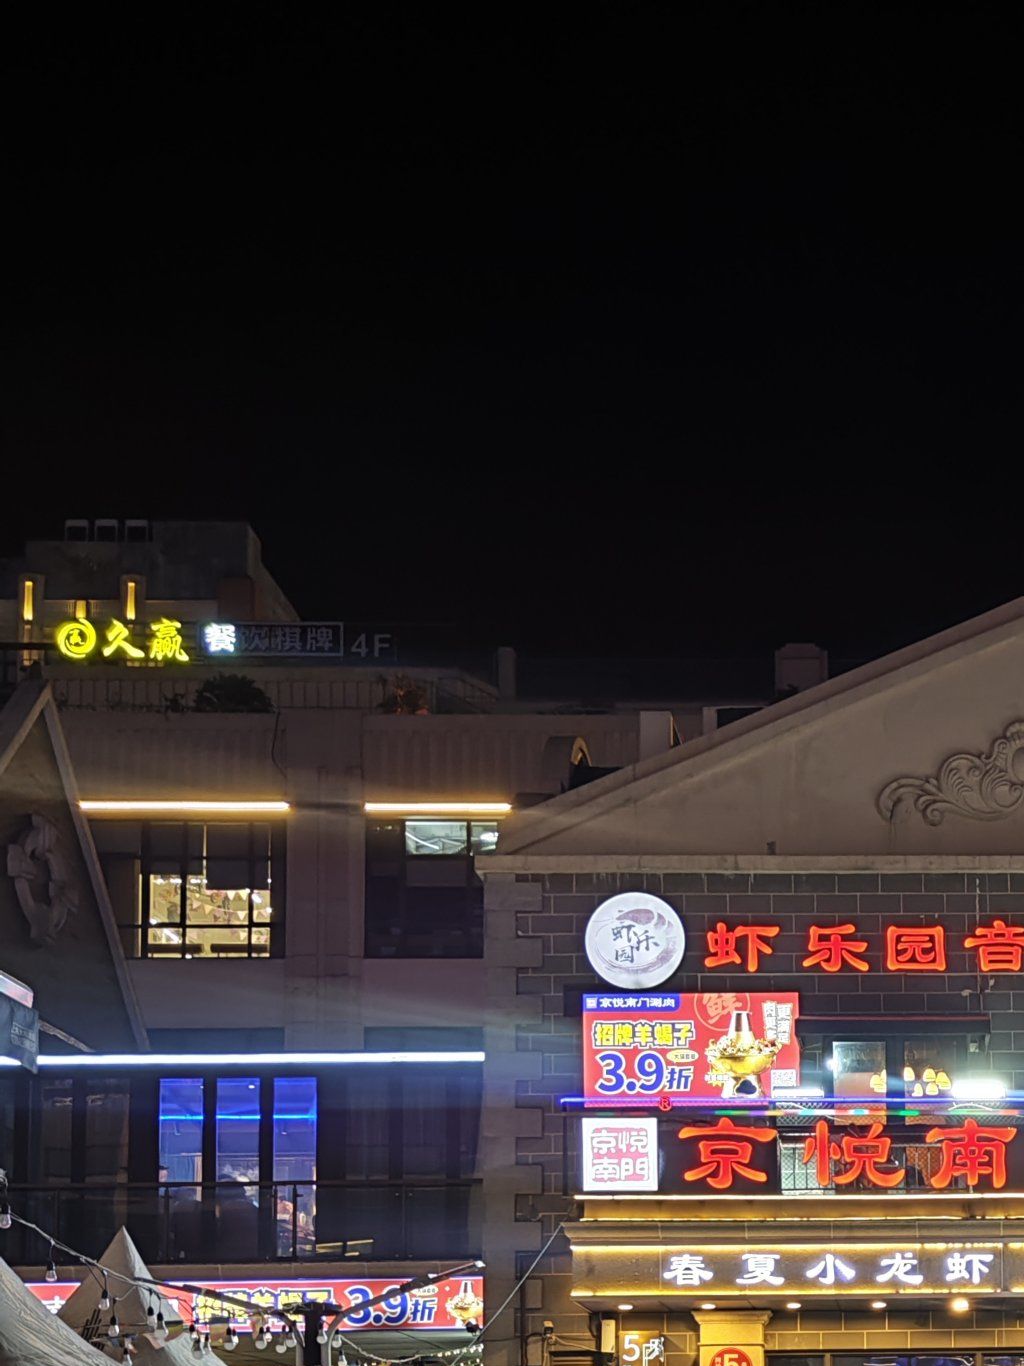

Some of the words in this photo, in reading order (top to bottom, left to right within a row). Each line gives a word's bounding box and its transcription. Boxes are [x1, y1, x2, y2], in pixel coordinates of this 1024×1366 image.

[351, 633, 392, 657] 4F
[599, 997, 675, 1009] 京悦南门涮肉
[592, 1021, 695, 1048] 招牌羊蝎子
[597, 1052, 694, 1094] 3.9折
[591, 1128, 649, 1154] 京悦
[663, 1252, 994, 1286] 春夏小龙虾
